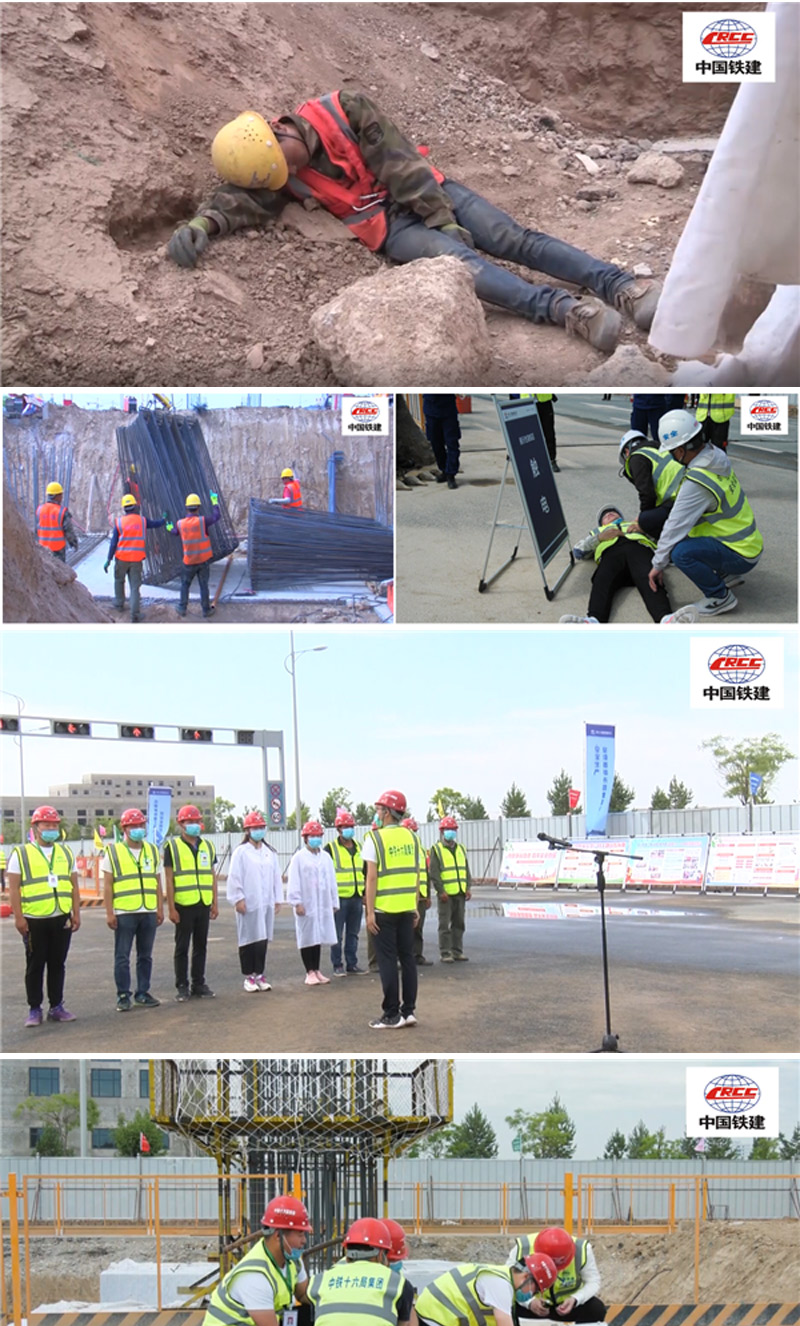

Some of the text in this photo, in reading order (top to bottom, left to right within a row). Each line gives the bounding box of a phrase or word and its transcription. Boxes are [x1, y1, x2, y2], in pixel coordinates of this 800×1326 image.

[328, 1276, 384, 1290] 中铁十六局集团
